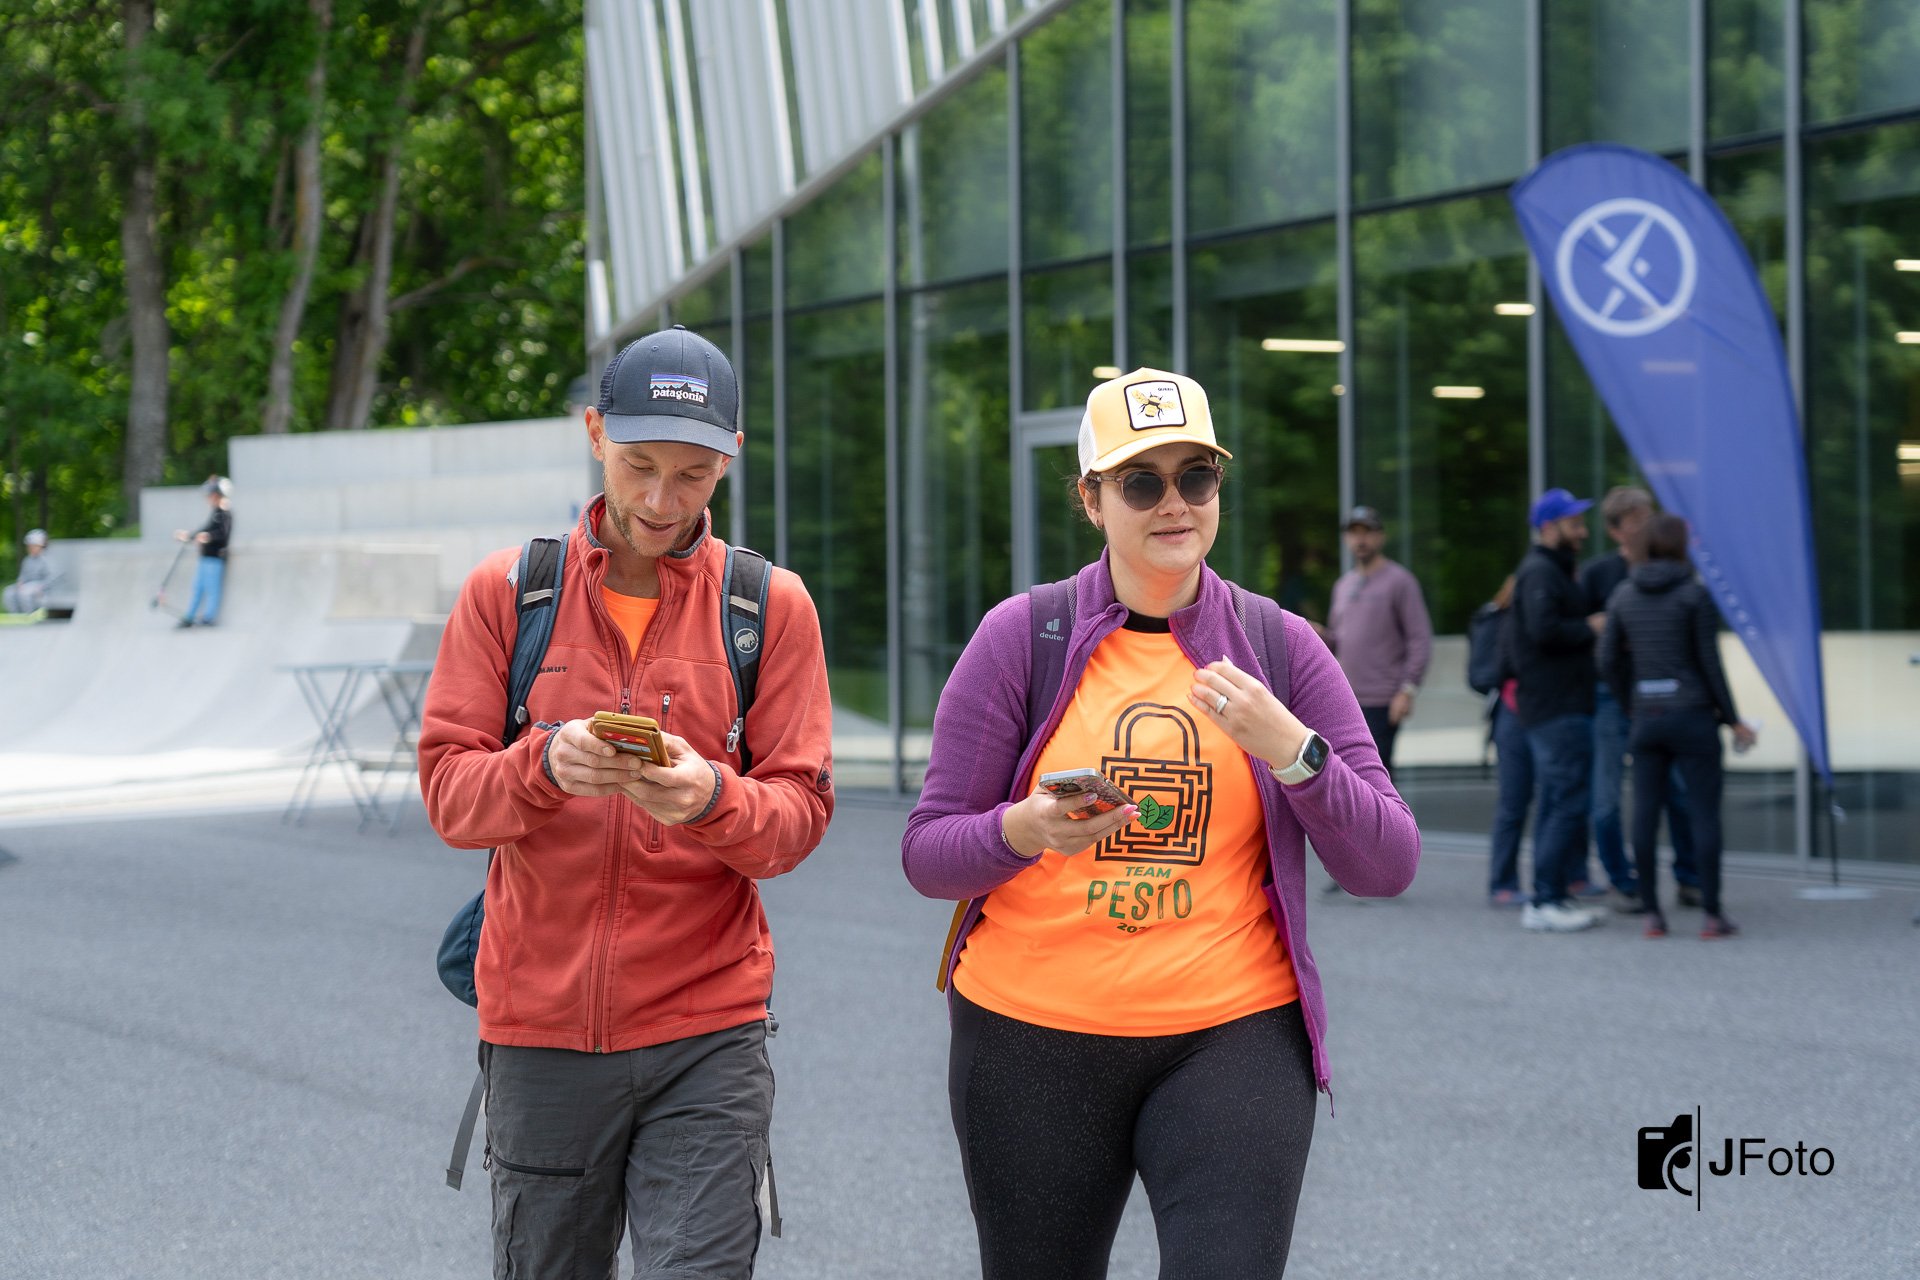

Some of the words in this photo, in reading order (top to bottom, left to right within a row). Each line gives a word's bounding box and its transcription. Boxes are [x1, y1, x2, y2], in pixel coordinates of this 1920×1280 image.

[652, 388, 704, 403] patagonia
[1039, 631, 1065, 642] deuter
[539, 665, 568, 674] MMUT
[1125, 866, 1172, 879] TEAM
[1085, 878, 1192, 920] PESTO
